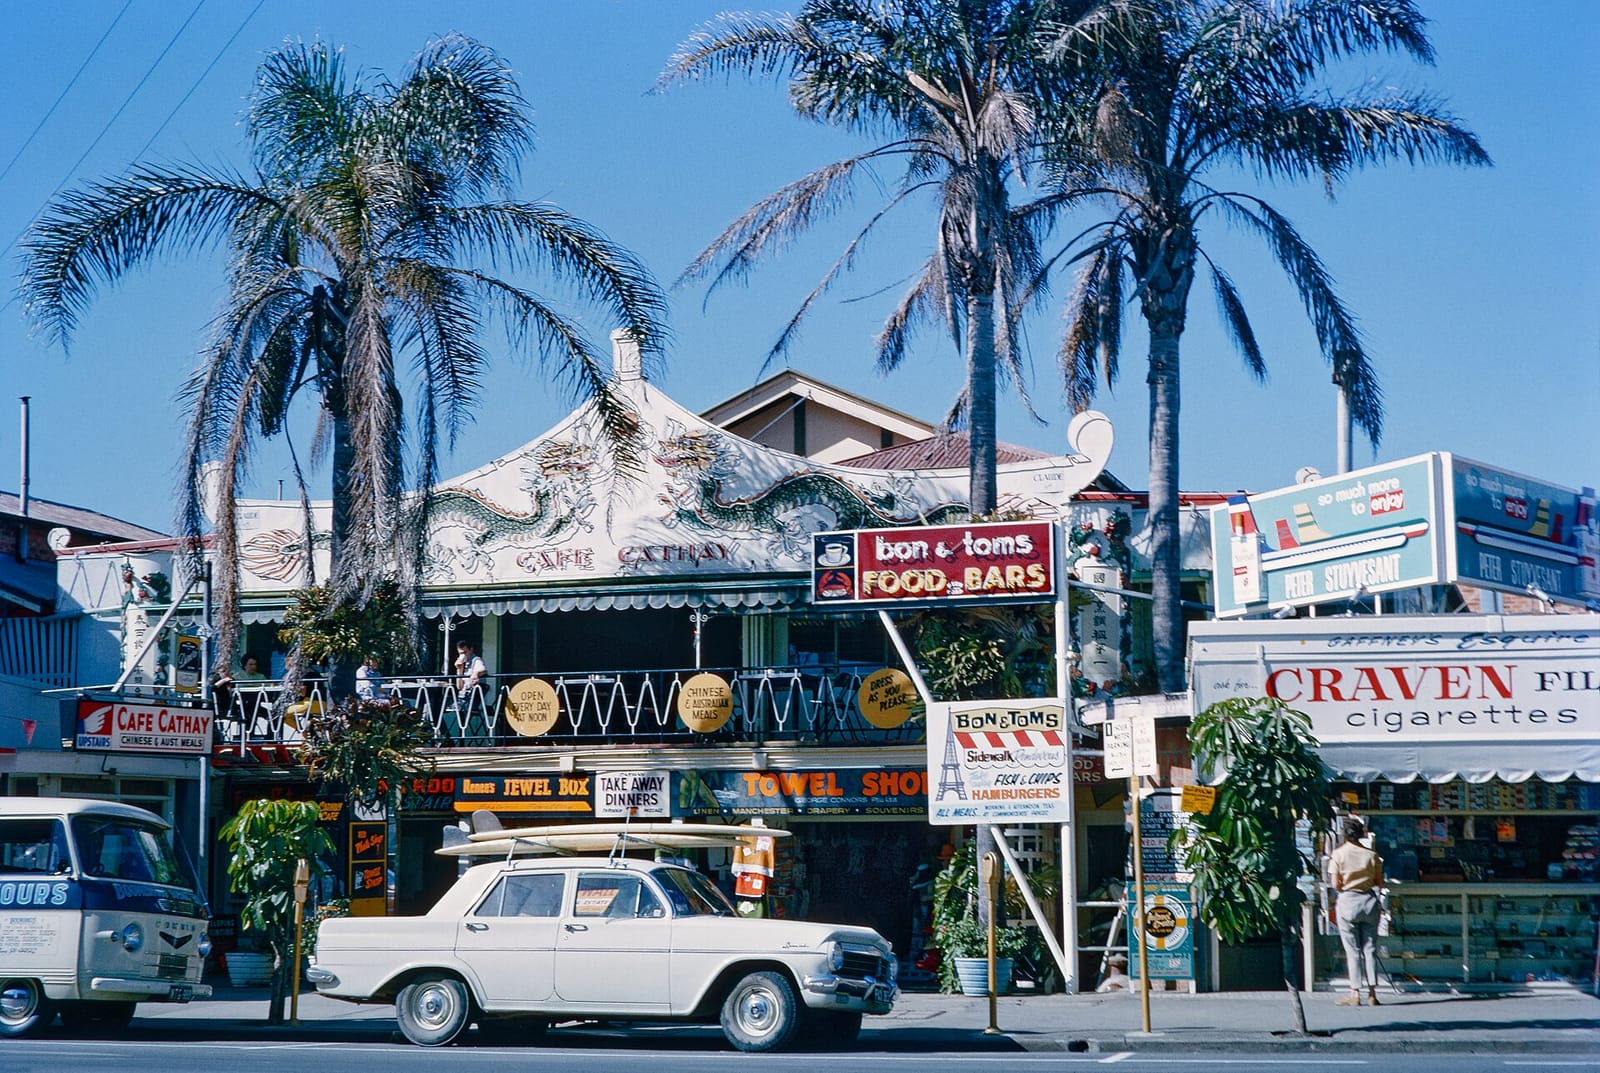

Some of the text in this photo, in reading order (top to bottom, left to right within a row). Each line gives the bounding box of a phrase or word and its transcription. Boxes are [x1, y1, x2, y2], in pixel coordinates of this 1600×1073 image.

[1317, 477, 1400, 506] so much more
[1465, 473, 1526, 499] so much more
[1351, 492, 1404, 516] to enjoy
[1491, 495, 1528, 519] to enjoy
[875, 531, 1033, 561] bon & toms
[516, 542, 728, 571] CAFE CATHAY
[863, 569, 947, 595] FOOD
[964, 563, 1047, 591] BARS
[1285, 553, 1401, 600] PETER STUYVESANT
[1479, 551, 1562, 593] PETER STUYVESANT
[1457, 631, 1590, 650] Esquire
[870, 674, 894, 691] DRESS
[1265, 664, 1600, 703] CRAVEN FIL
[521, 690, 544, 701] OPEN
[687, 687, 725, 698] CHINESE
[868, 684, 901, 704] AS YOU
[879, 692, 907, 712] PLEASE
[536, 701, 551, 711] DAY
[692, 710, 719, 720] MEALS
[117, 706, 210, 735] CAFE CATHAY
[528, 711, 548, 722] NOON
[1346, 703, 1579, 732] cigarettes
[79, 736, 110, 747] UPSTAIRS
[121, 735, 153, 746] CHINESE
[181, 739, 203, 748] MEALS
[967, 750, 1015, 763] Sidewalk
[503, 778, 552, 796] JEWEL
[558, 778, 590, 796] BOX
[601, 777, 665, 792] TAKE AWAY
[744, 772, 844, 796] TOWEL
[994, 774, 1018, 786] FISH
[1028, 772, 1063, 785] CHIPS
[606, 793, 658, 806] DINNERS
[972, 788, 1060, 800] HAMBURGERS
[732, 807, 793, 816] MANCHESTER
[865, 807, 924, 815] SOUVENIRS
[936, 809, 949, 818] ALL
[0, 883, 70, 905] OURS
